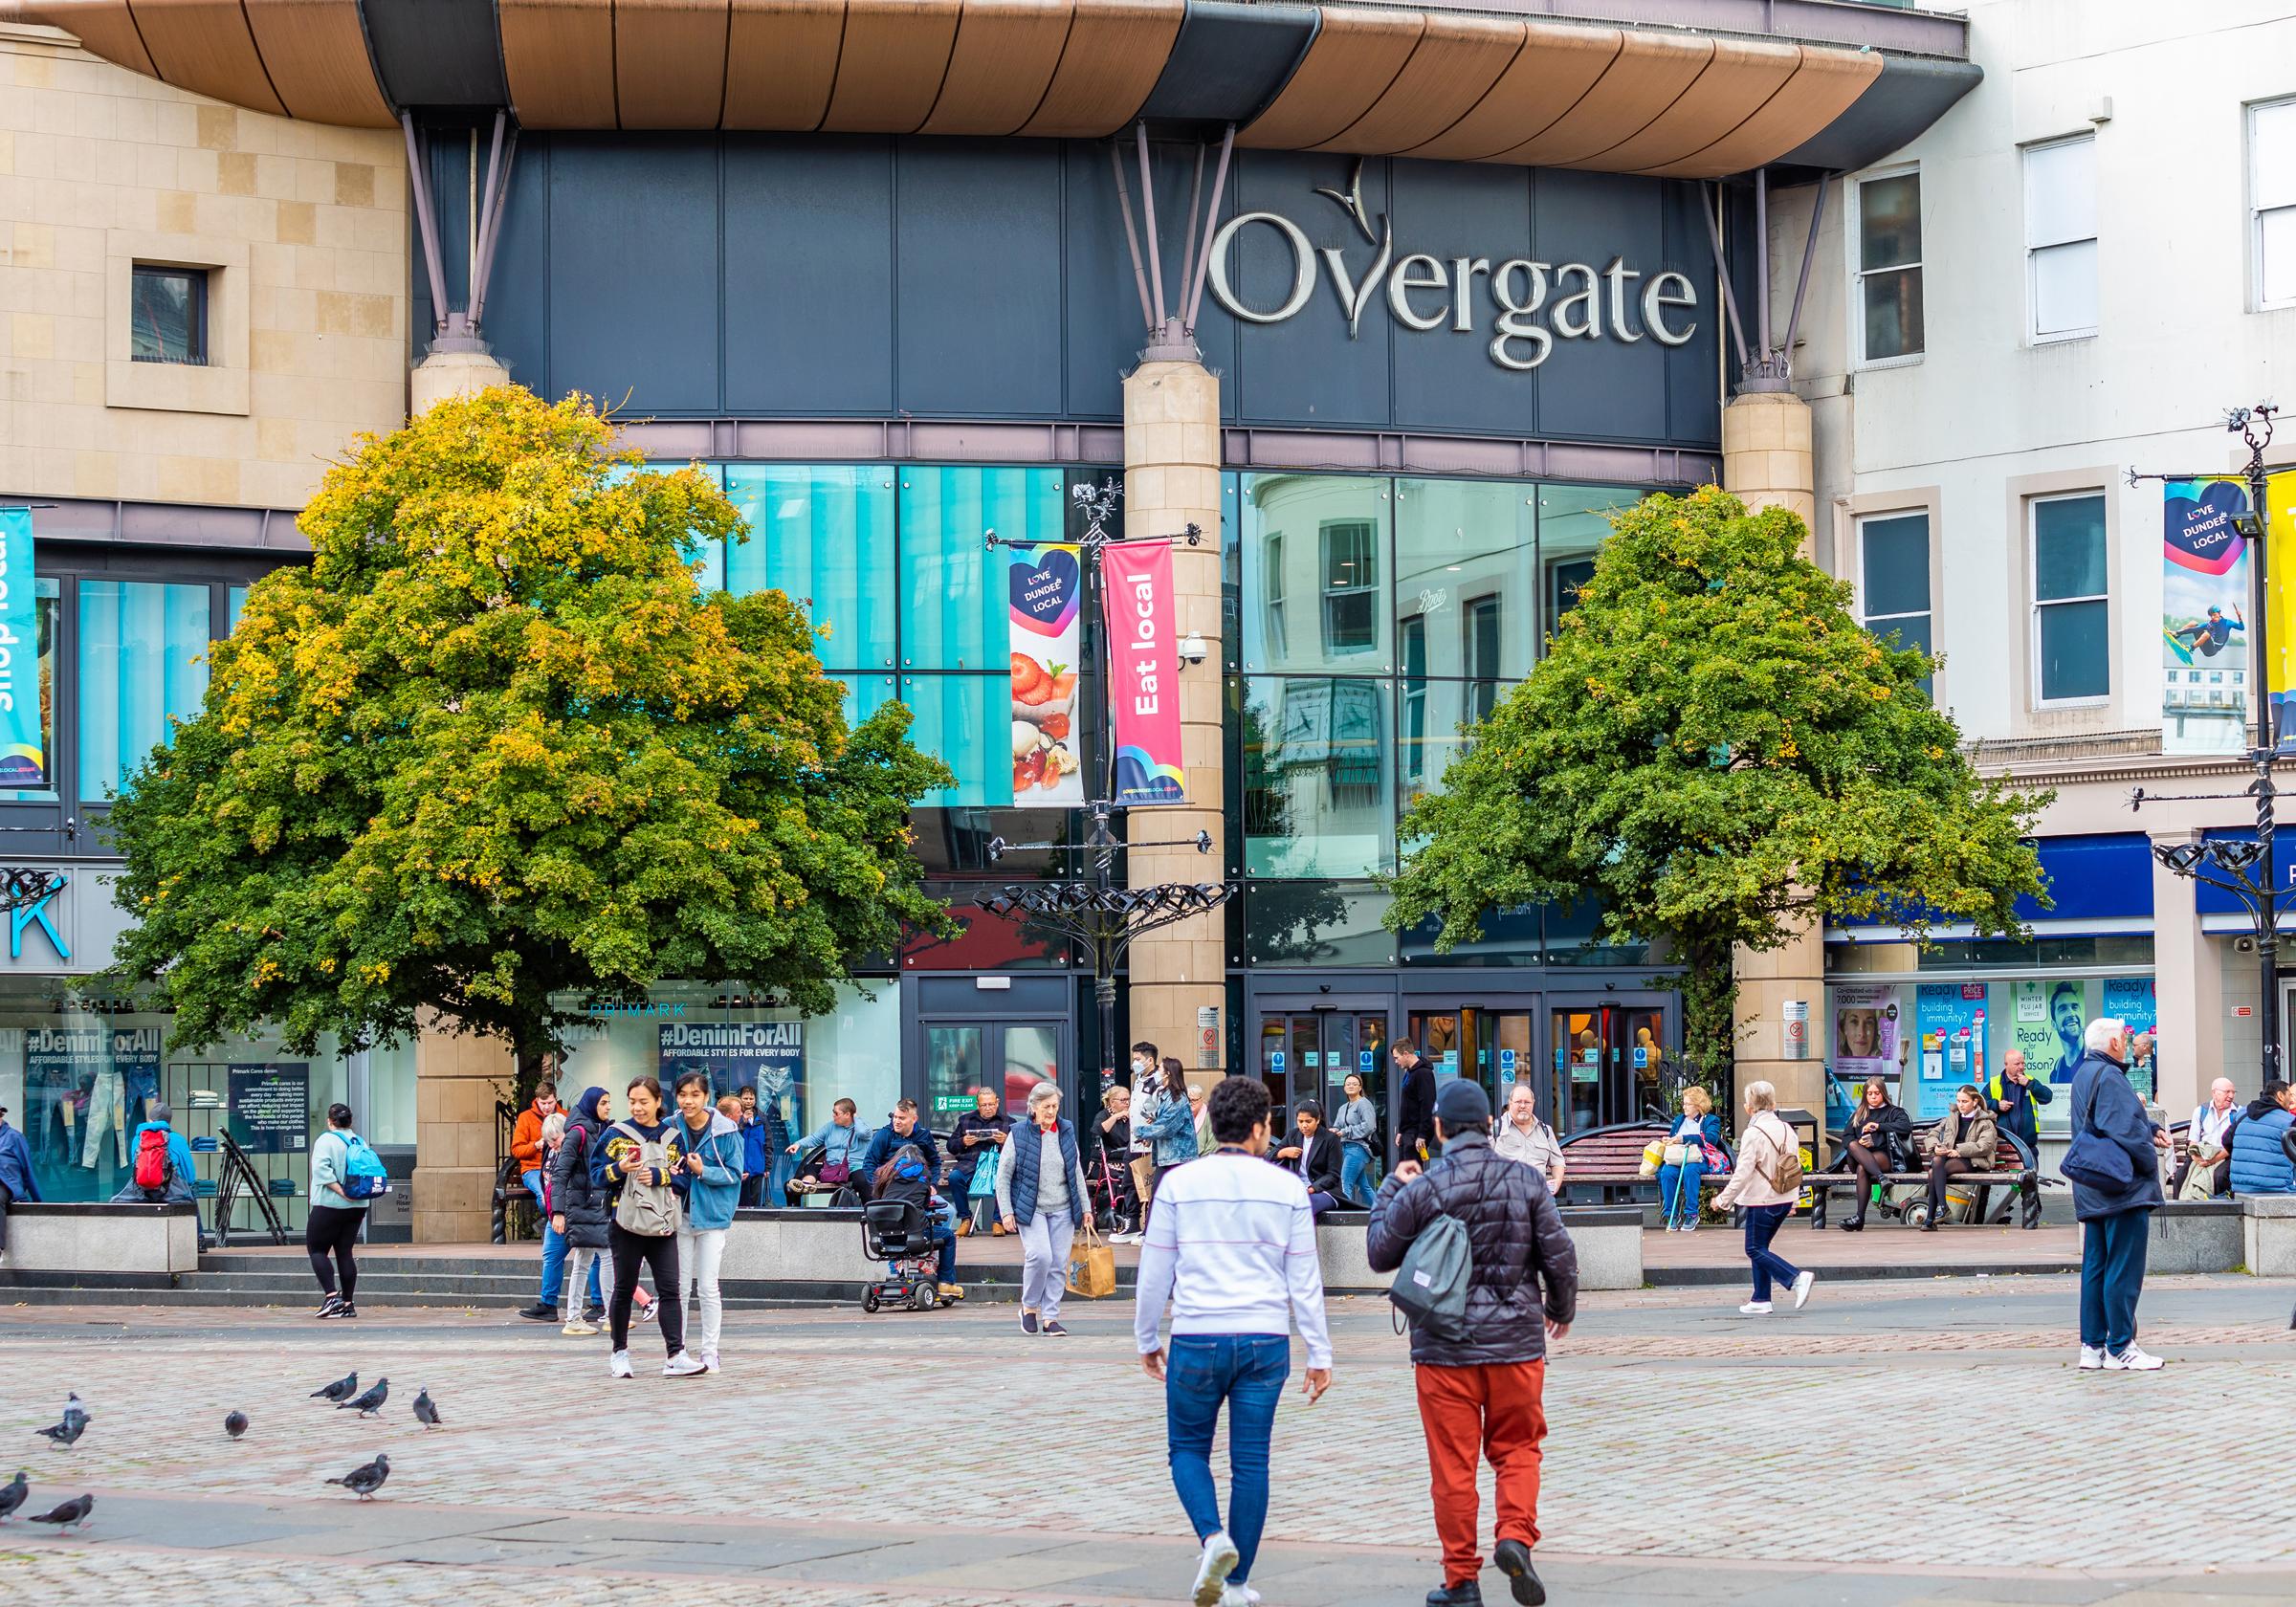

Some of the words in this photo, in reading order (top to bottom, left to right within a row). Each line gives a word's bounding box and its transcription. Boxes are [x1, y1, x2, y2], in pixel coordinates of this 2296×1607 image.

[1207, 196, 1697, 370] Overgate
[2187, 504, 2215, 521] LOVE
[2183, 516, 2227, 538] DUNDEE
[2194, 531, 2228, 550] LOCAL
[1027, 571, 1051, 585] LOVE
[1025, 581, 1062, 601] DUNDEE
[1033, 596, 1062, 612] LOCAL
[1127, 574, 1155, 650] local
[1136, 660, 1159, 715] Eat
[1921, 984, 1957, 999] Ready
[2109, 980, 2146, 996] Ready
[589, 1003, 686, 1018] PRIMARK
[1921, 1003, 1953, 1014] building
[2109, 1000, 2141, 1012] building
[1926, 1012, 1967, 1024] immunity?
[2114, 1010, 2157, 1022] immunity?
[28, 1029, 158, 1052] #DenimForAll
[661, 1024, 801, 1046] #DenimForAll
[2017, 1027, 2052, 1046] Ready
[29, 1055, 73, 1063] AFFORDABLE
[75, 1055, 99, 1063] STYLES
[116, 1055, 137, 1063] EVERY
[139, 1055, 157, 1063] BODY
[663, 1048, 710, 1057] AFFORDABLE
[740, 1048, 754, 1057] FOR
[755, 1048, 779, 1057] EVERY
[780, 1048, 800, 1057] BODY
[2023, 1057, 2054, 1070] eason?
